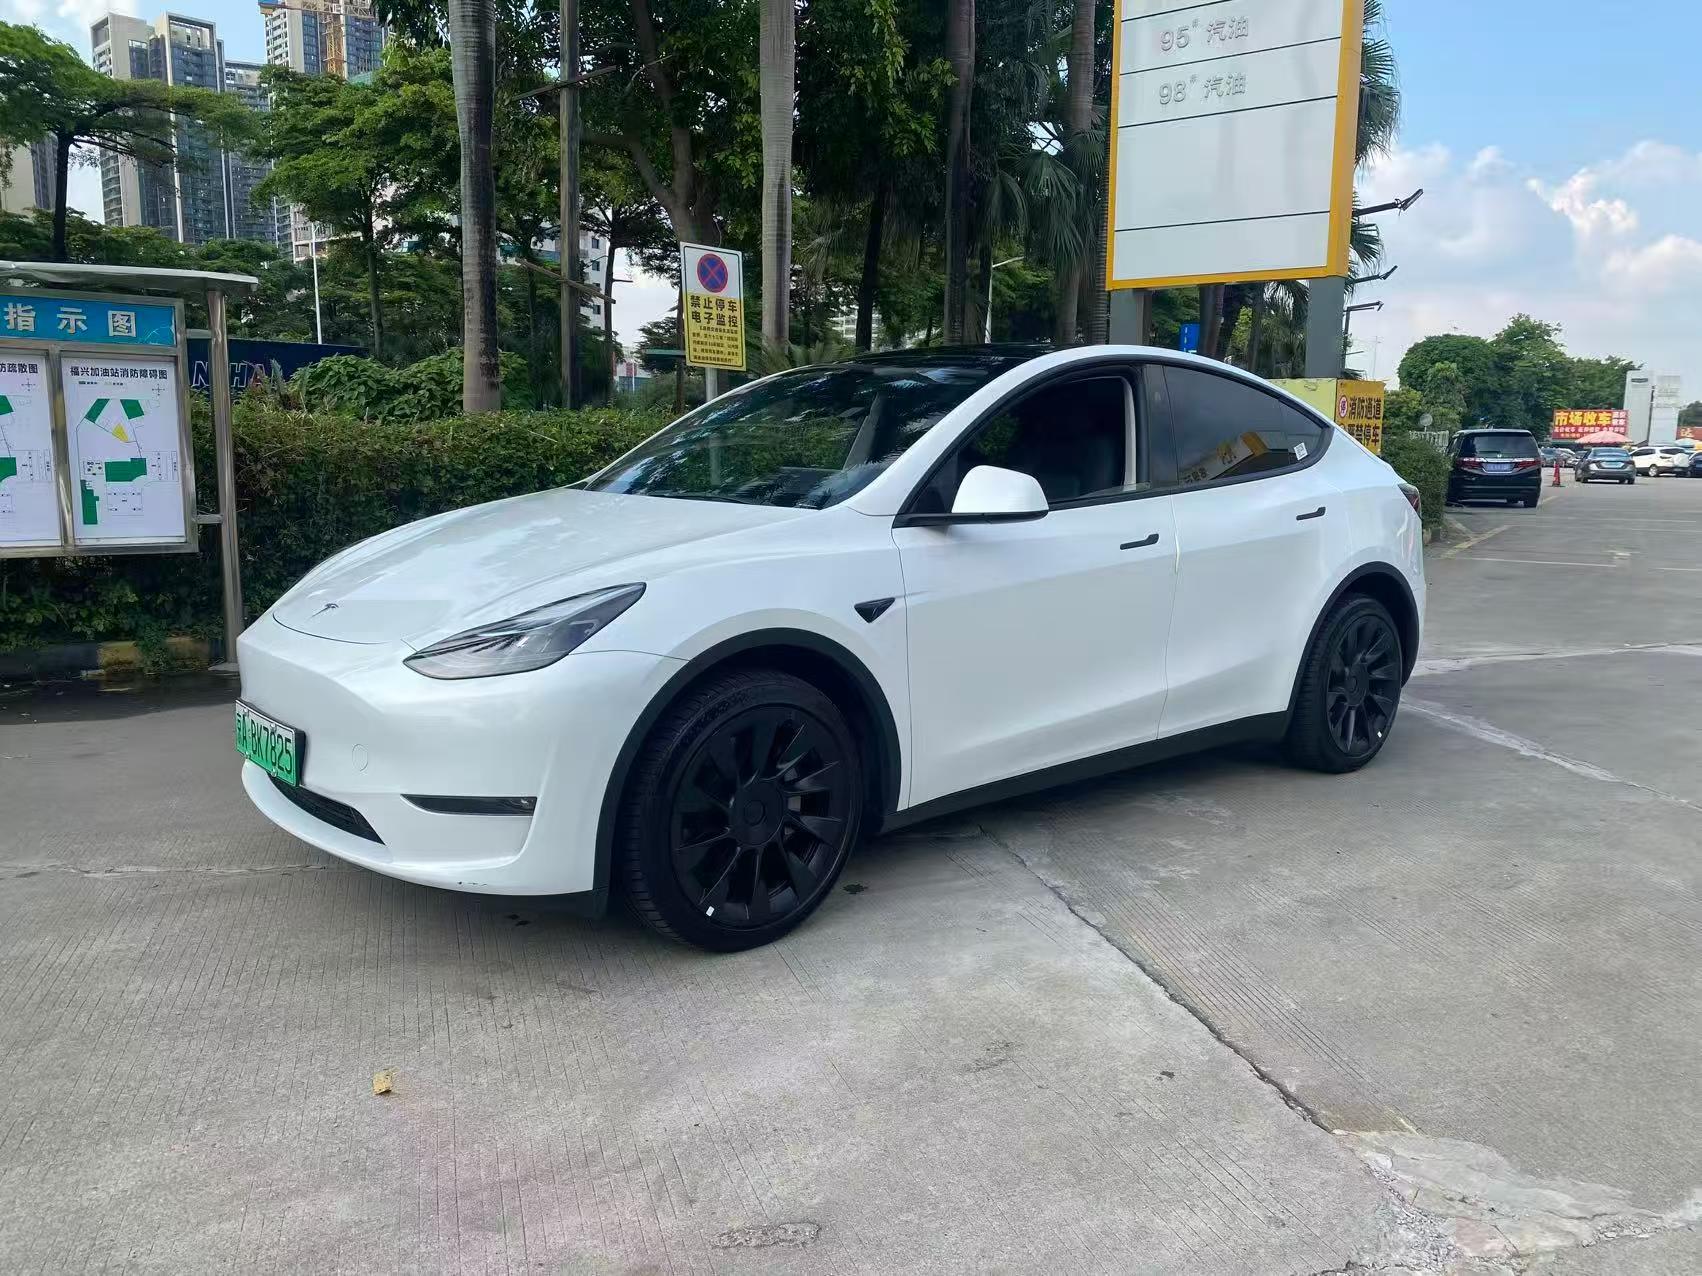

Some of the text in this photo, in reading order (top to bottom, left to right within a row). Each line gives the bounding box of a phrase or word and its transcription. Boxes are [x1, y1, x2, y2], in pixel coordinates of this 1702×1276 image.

[1207, 15, 1249, 45] 汽油
[1203, 72, 1246, 99] 汽油
[690, 295, 738, 313] 禁止停车
[4, 302, 137, 338] 指示图
[691, 310, 739, 328] 电子监控
[70, 365, 168, 380] 福兴加油站消防障碍图
[1349, 395, 1381, 420] 消防通道
[1555, 411, 1612, 426] 市场收车
